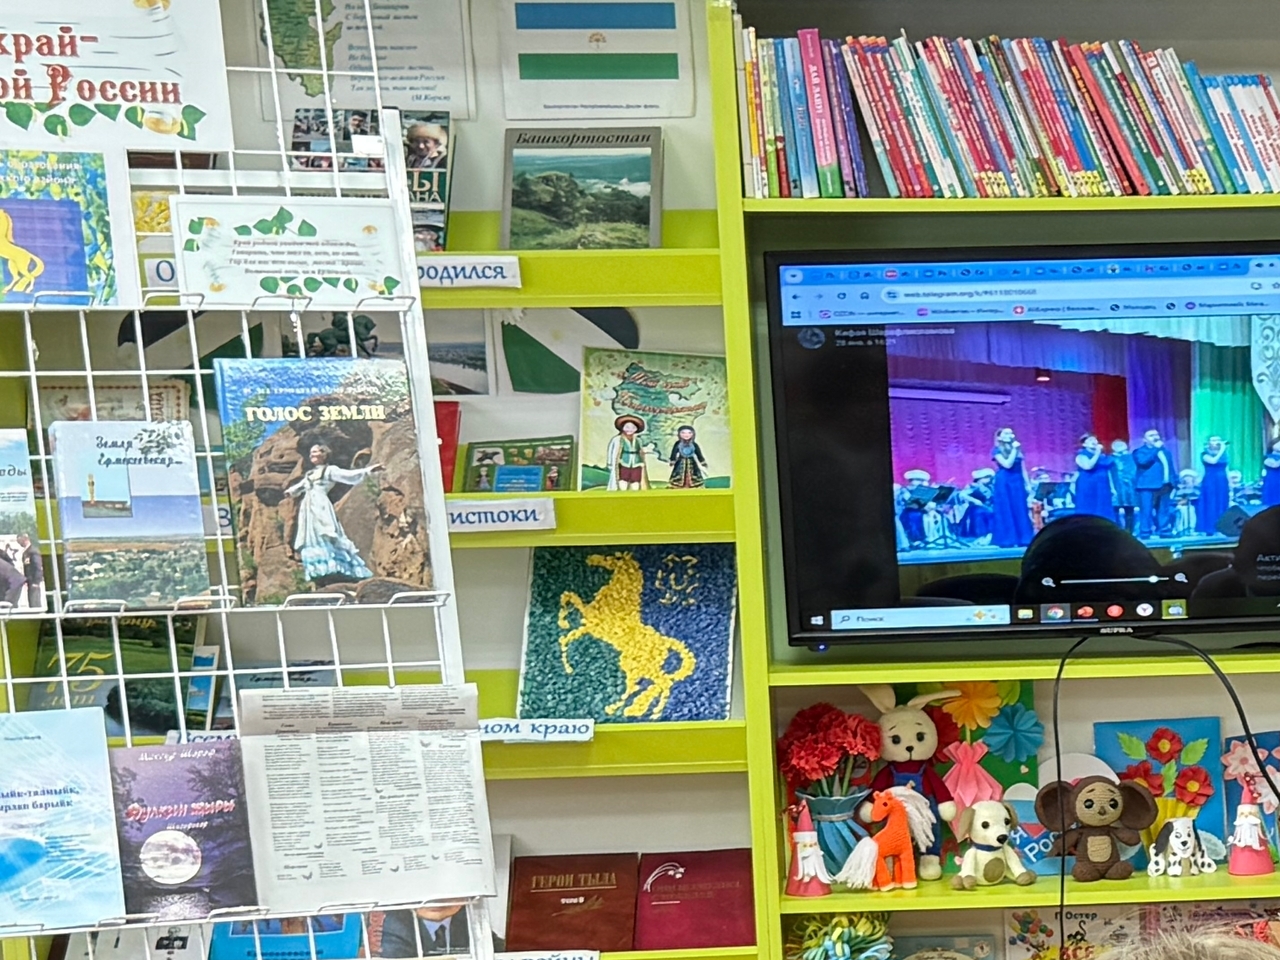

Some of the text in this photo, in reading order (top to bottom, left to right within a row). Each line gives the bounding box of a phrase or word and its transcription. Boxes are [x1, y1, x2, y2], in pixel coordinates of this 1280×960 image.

[41, 64, 182, 111] России
[516, 132, 652, 146] Башкортостан
[245, 404, 386, 422] ГОЛОС ЗЕМЛИ
[449, 506, 539, 524] истоки
[47, 652, 113, 693] 75
[531, 723, 590, 739] краю
[531, 872, 618, 889] ГЕРОИ ТЫЛА
[1065, 910, 1098, 920] Остер
